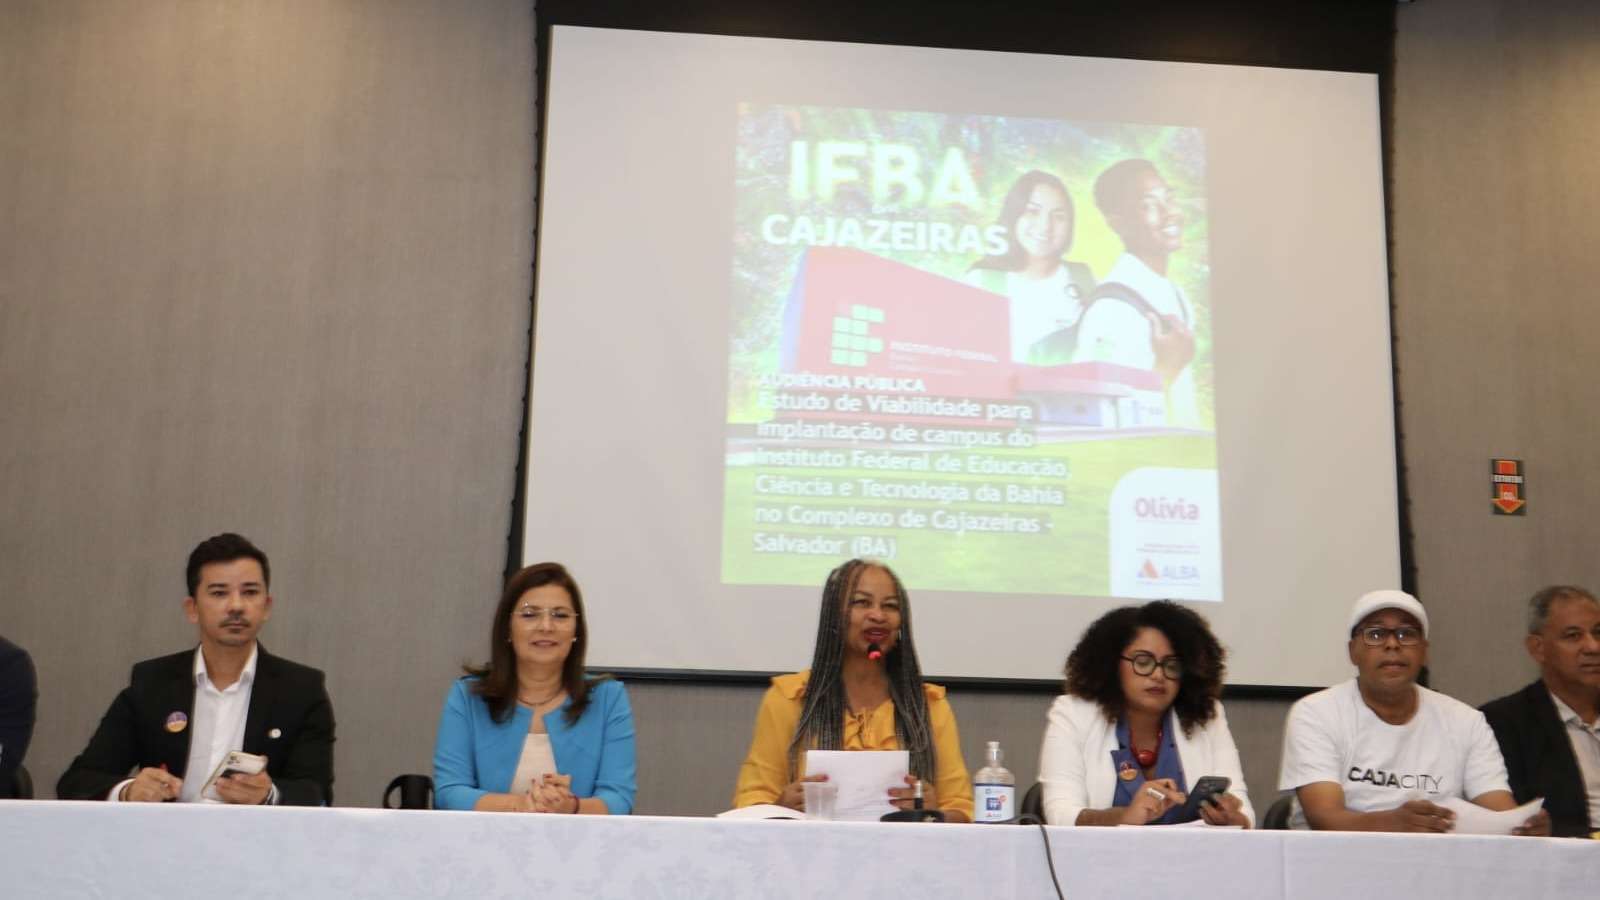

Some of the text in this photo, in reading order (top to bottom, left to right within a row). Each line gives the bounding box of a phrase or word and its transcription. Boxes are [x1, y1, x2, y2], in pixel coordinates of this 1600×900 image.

[789, 139, 983, 211] IFBA
[761, 213, 1008, 256] CAJAZEIRAS
[759, 371, 926, 392] AUDIÊNCIA PÚBLICA
[759, 391, 1032, 423] Estudo de Viabilidade para
[890, 423, 918, 442] de
[922, 429, 1002, 448] campus
[1007, 427, 1033, 447] do
[851, 450, 930, 472] Federal
[935, 453, 961, 472] de
[755, 473, 1065, 504] Ciência e Tecnologia da Bahia
[754, 507, 783, 522] no
[787, 505, 894, 530] Complexo
[898, 508, 928, 528] de
[931, 509, 1041, 537] Cajazeiras
[753, 532, 898, 560] Salvador (BA)
[1347, 766, 1443, 791] CAJACITY
